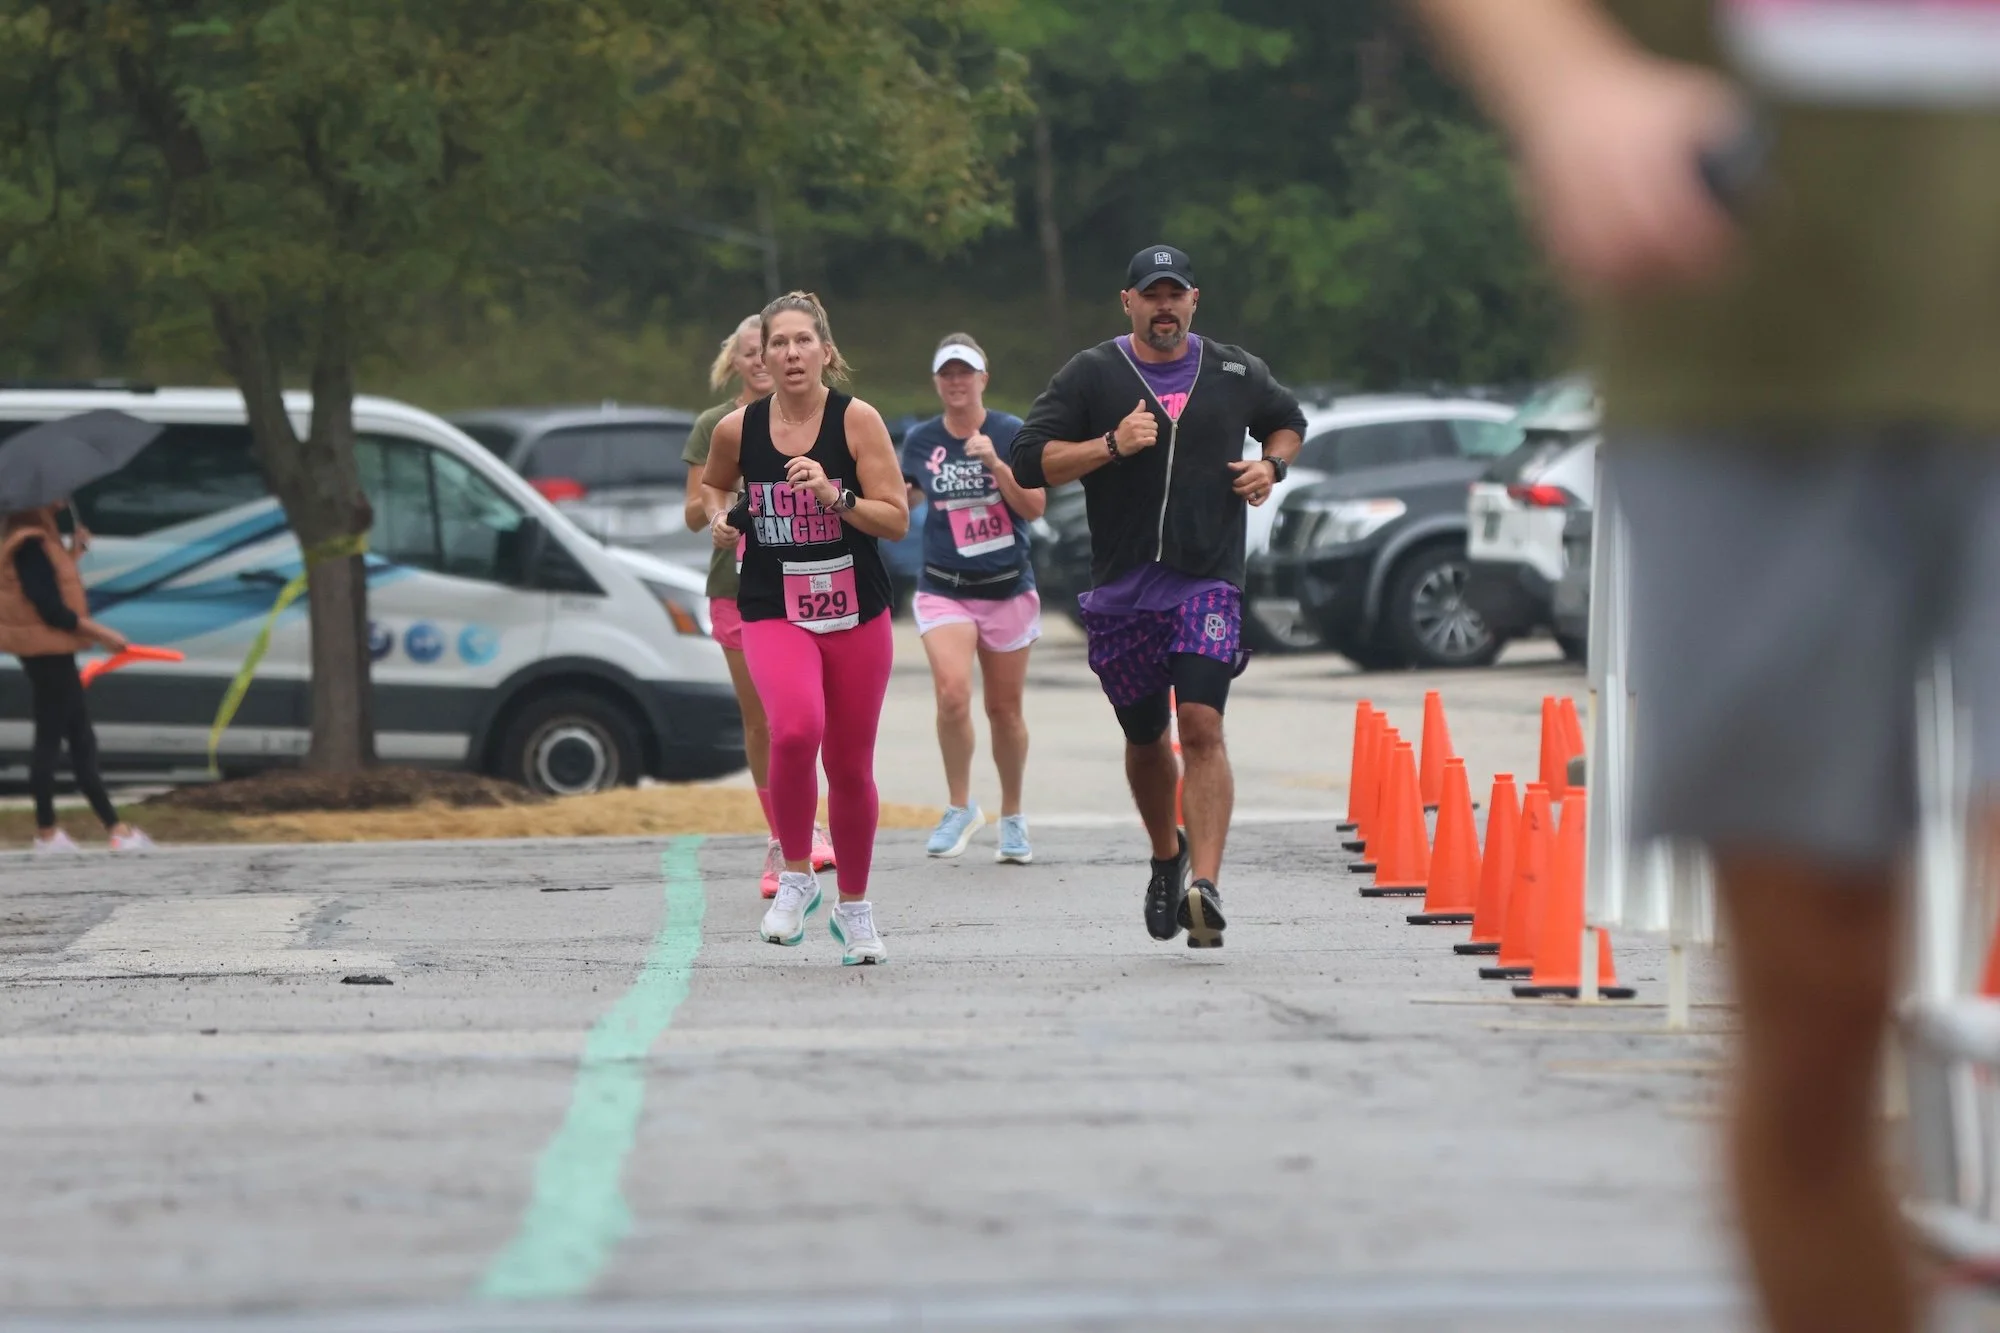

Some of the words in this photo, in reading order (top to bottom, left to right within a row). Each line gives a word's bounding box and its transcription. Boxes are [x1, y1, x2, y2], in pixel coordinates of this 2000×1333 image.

[932, 475, 984, 493] Grace
[942, 463, 982, 480] Race
[753, 514, 841, 544] CANCER
[965, 515, 1002, 541] 449
[798, 590, 848, 619] 529
